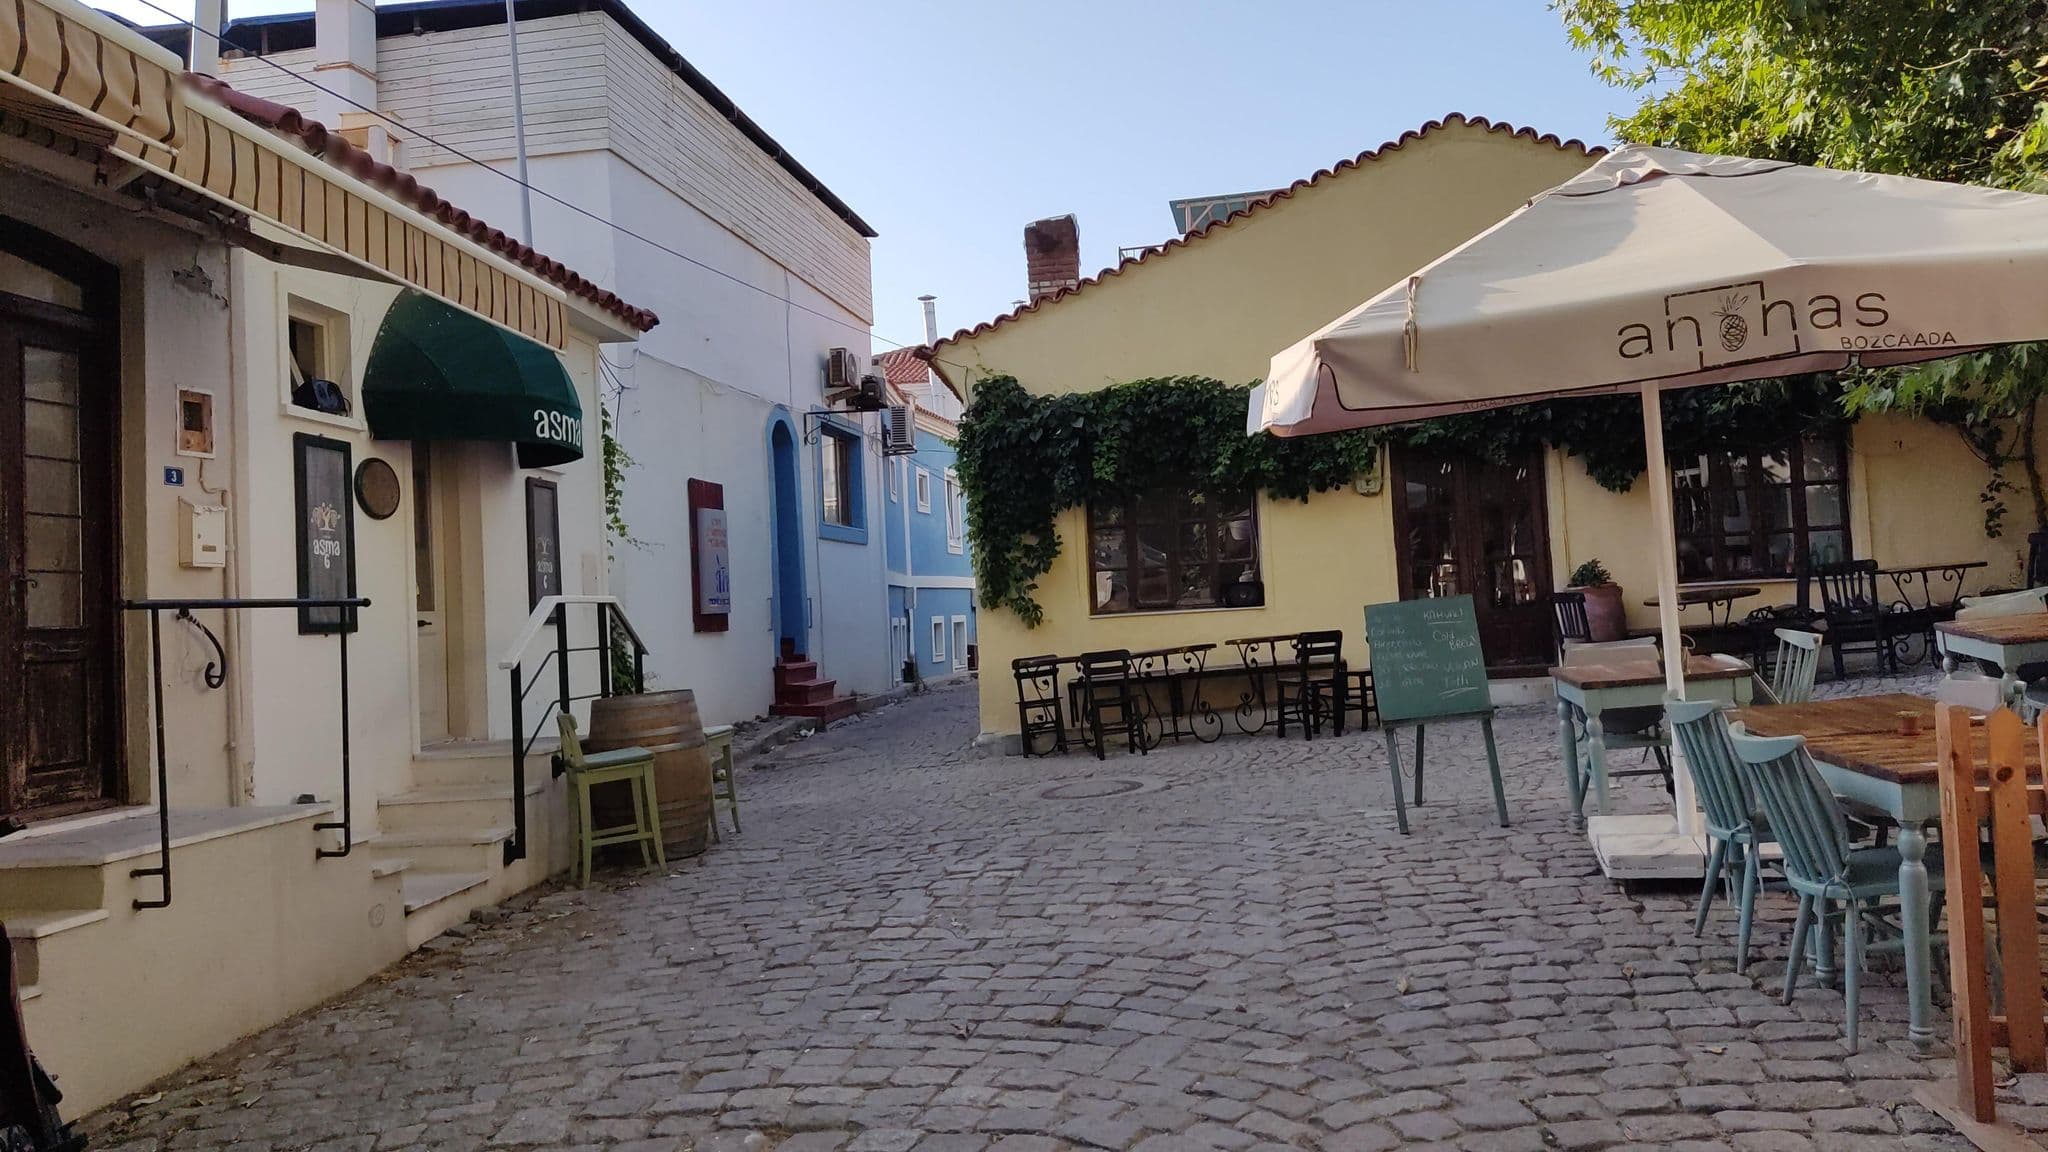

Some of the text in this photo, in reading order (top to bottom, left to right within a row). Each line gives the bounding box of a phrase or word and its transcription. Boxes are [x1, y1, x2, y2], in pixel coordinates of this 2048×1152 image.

[1840, 331, 1957, 350] BOZCAADA
[533, 409, 582, 447] asma
[171, 470, 177, 482] 3
[312, 538, 341, 557] asma
[323, 553, 331, 569] 6
